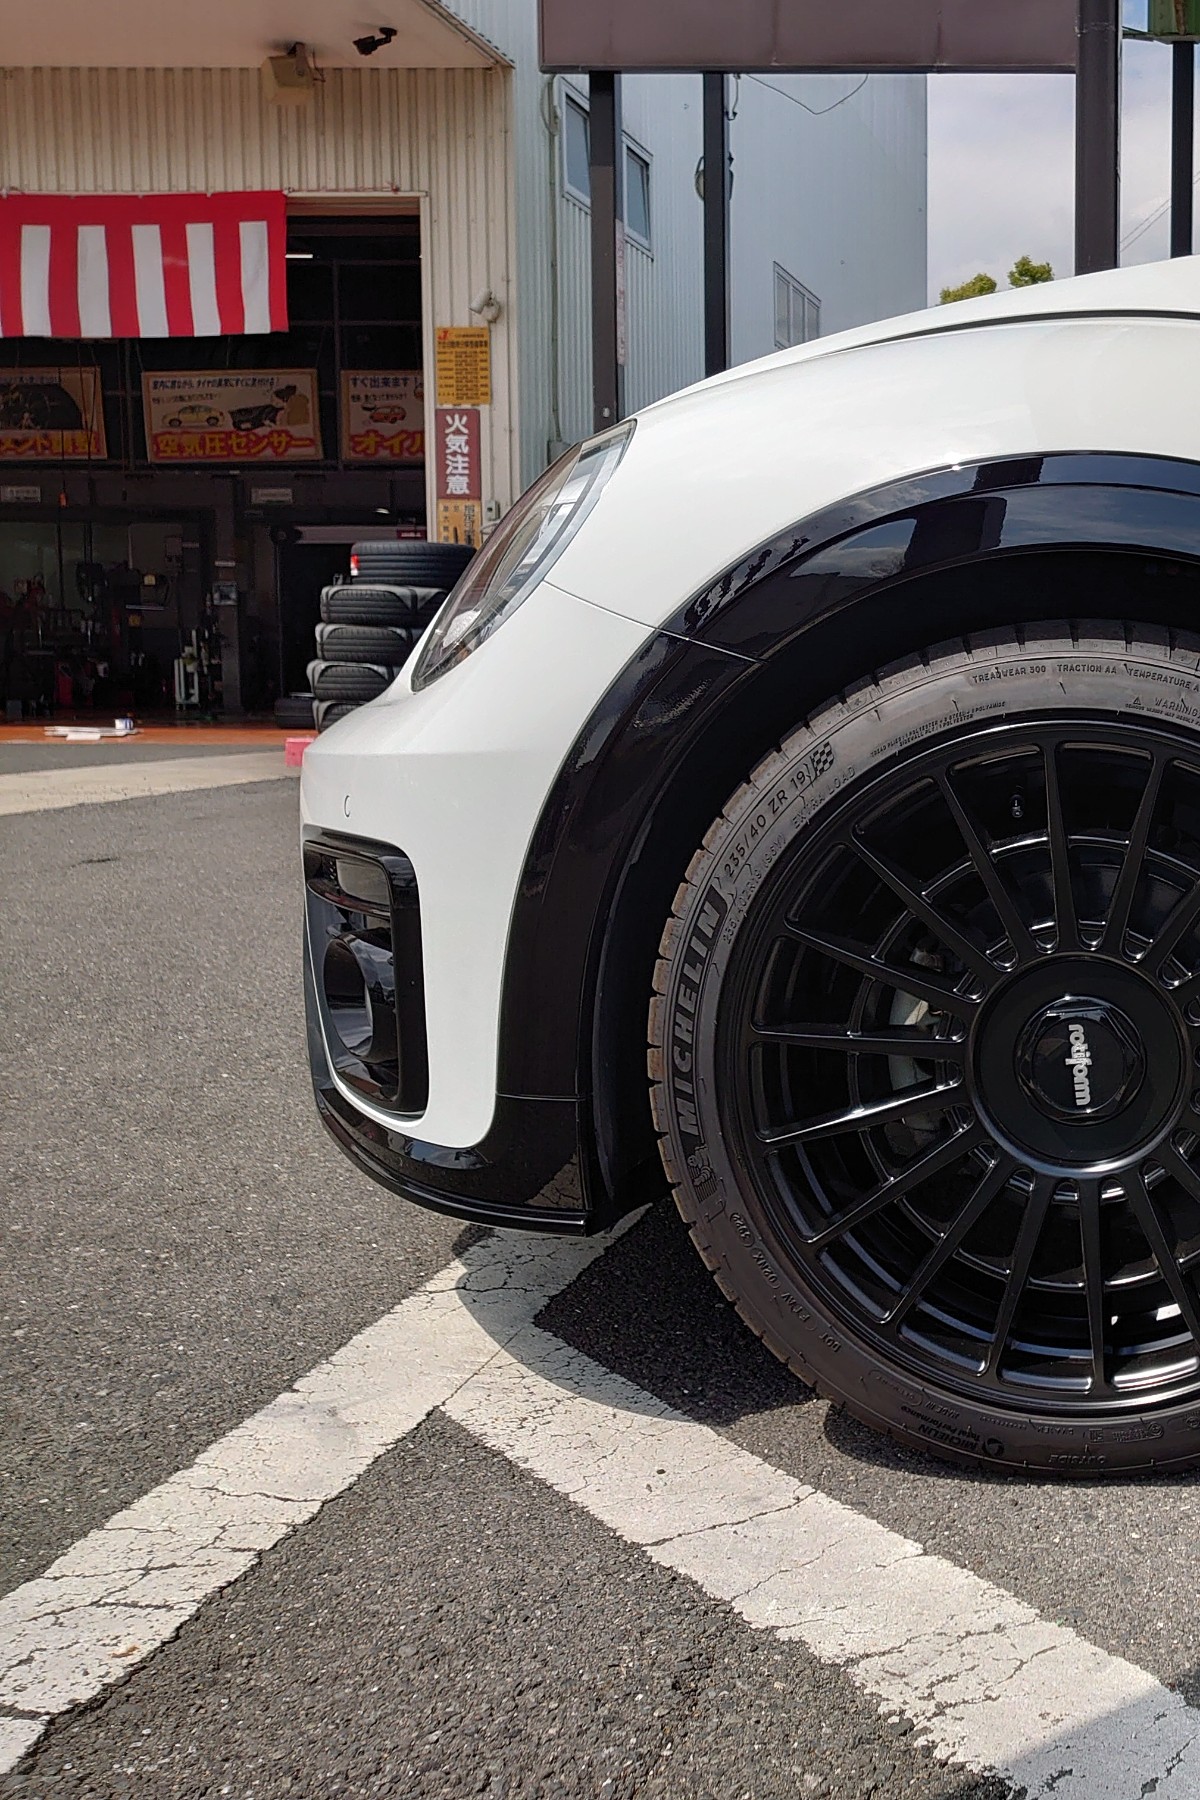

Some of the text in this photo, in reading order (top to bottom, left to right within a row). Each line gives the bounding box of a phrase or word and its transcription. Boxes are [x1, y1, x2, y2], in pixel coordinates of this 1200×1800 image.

[157, 432, 311, 457] 空気圧センサー
[1029, 665, 1047, 675] 300
[1056, 663, 1102, 674] TRACTION
[1104, 665, 1117, 675] AA
[1128, 667, 1192, 690] TEMPERATURE
[1191, 683, 1200, 693] A
[828, 766, 856, 795] LOAD
[723, 770, 807, 878] 235/40 ZR 19
[673, 904, 721, 1135] MICHELIN
[1065, 1024, 1092, 1106] rotiform
[901, 1405, 981, 1442] Total Performance
[918, 1423, 979, 1450] MICHELIN
